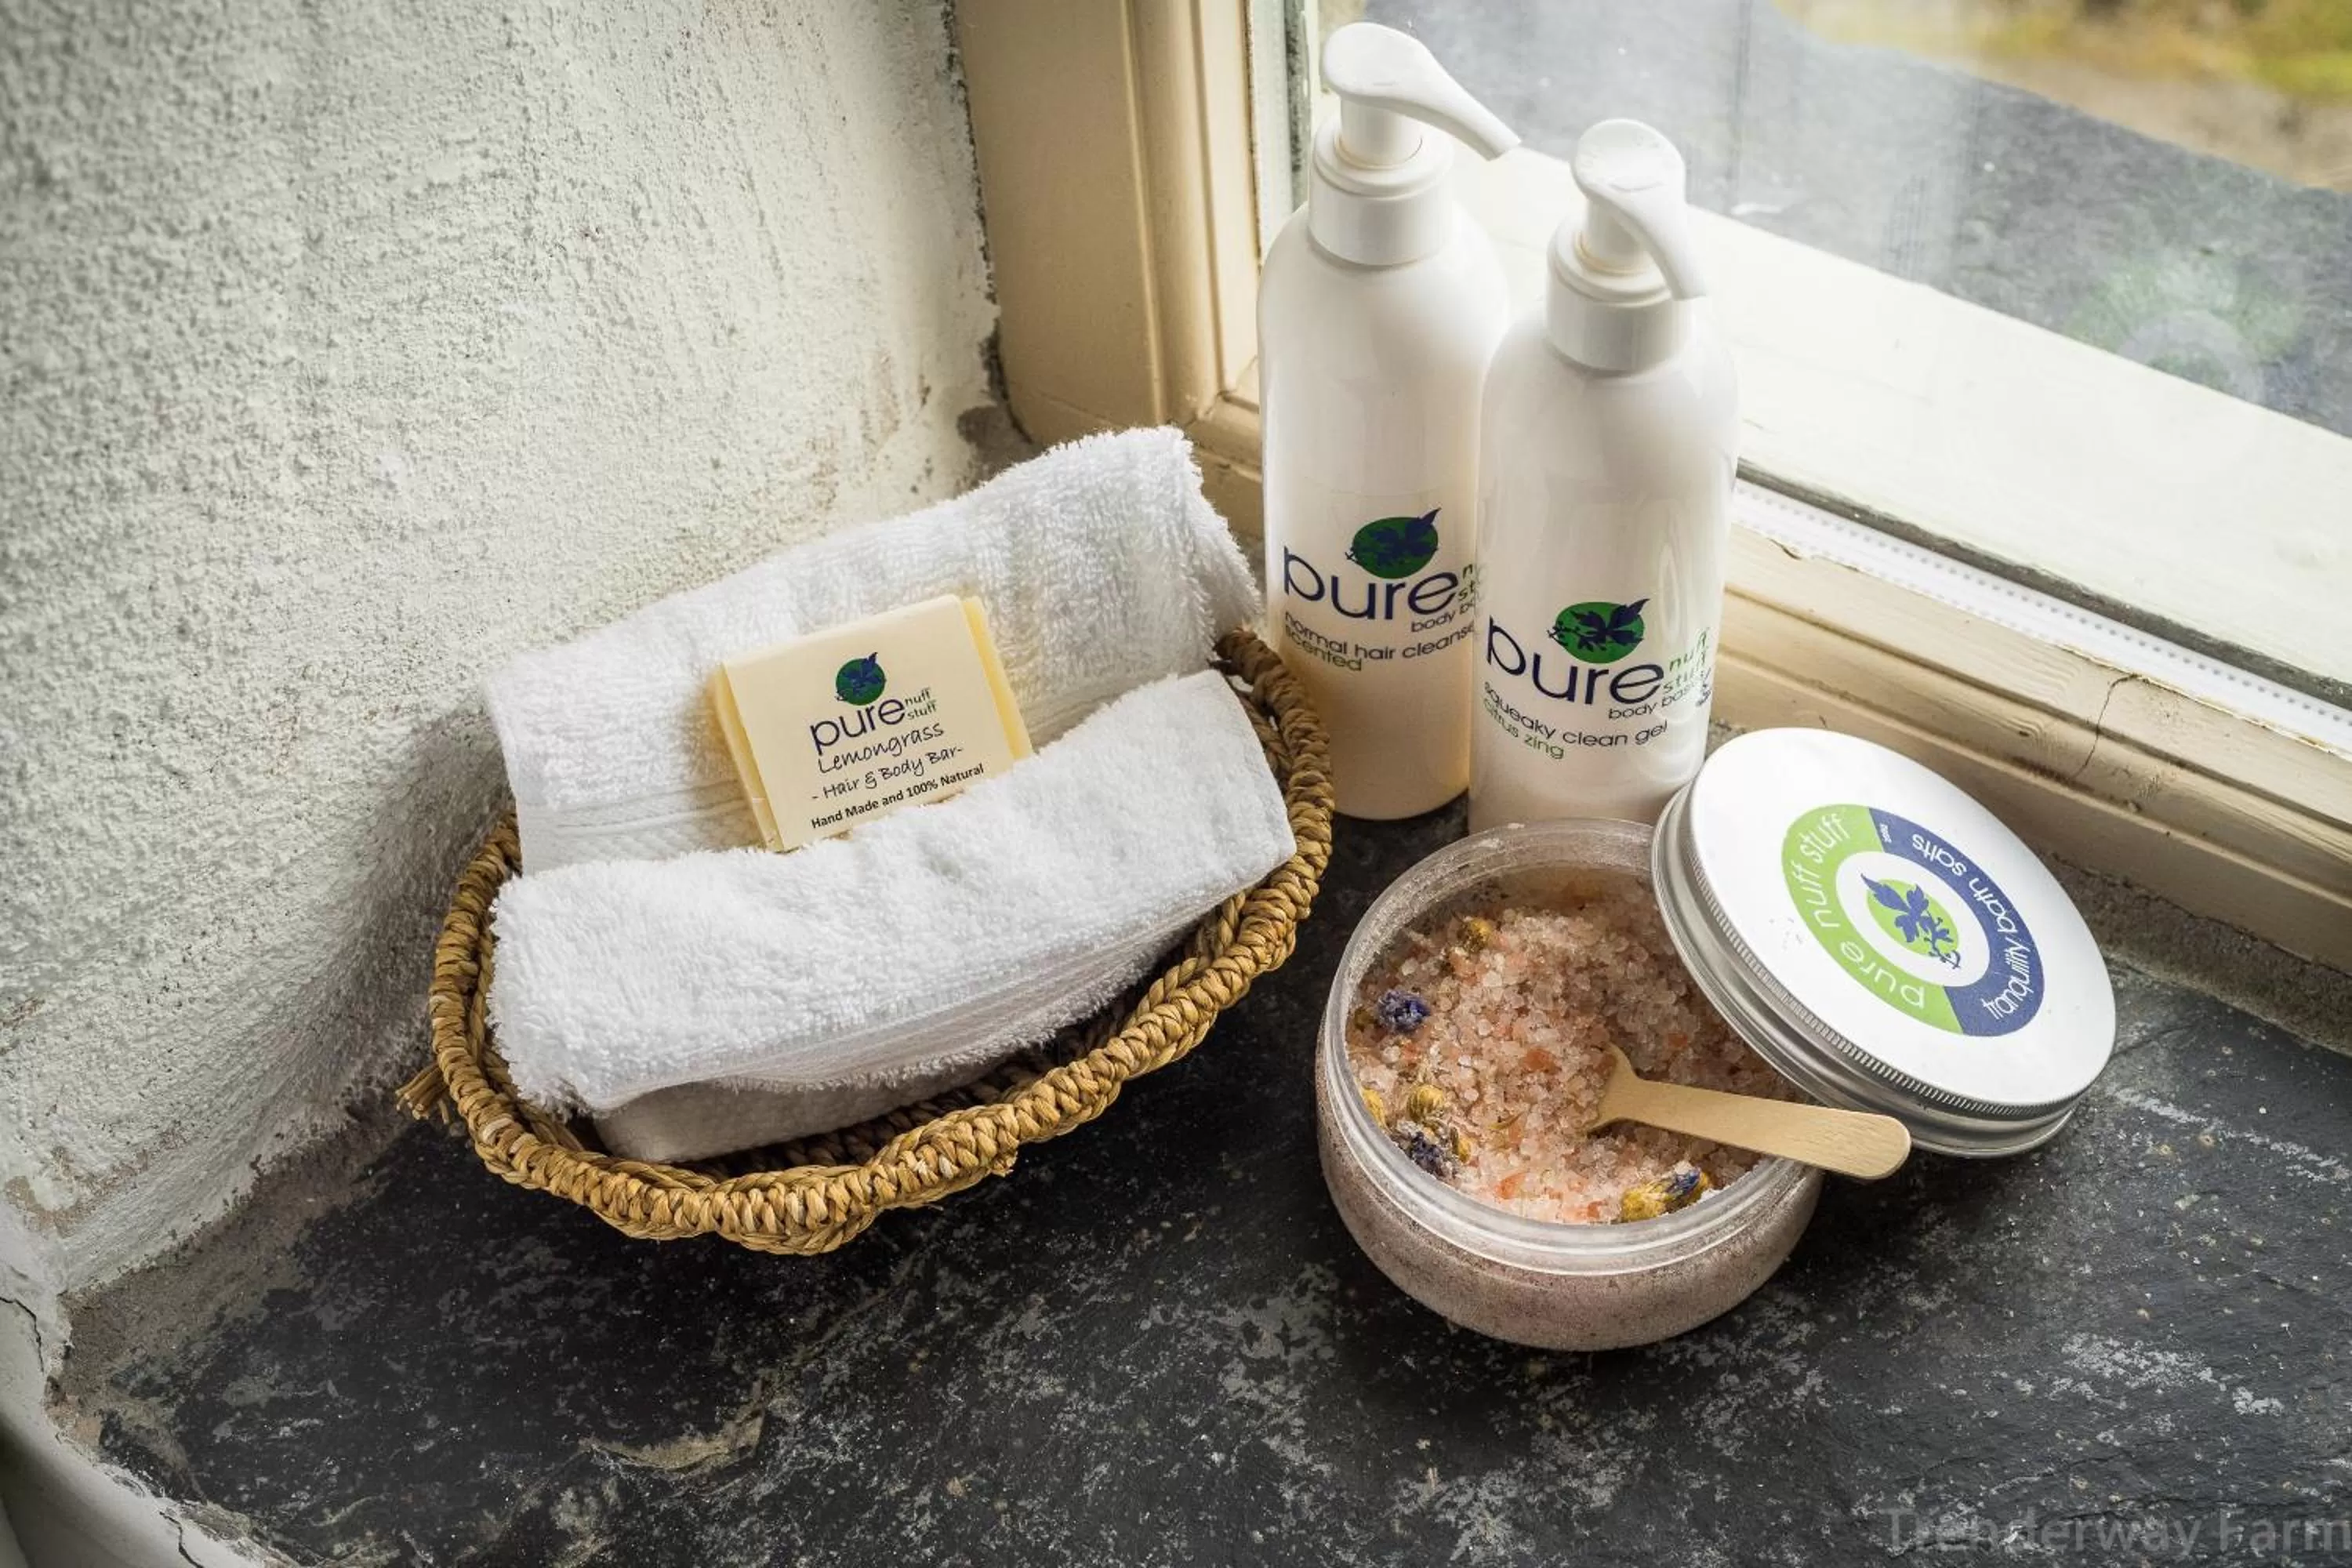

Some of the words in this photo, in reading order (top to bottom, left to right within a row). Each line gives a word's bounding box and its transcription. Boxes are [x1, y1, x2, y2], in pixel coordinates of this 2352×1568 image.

[1283, 546, 1459, 620] pure
[1285, 612, 1348, 655] normal
[1354, 643, 1396, 659] hair
[1411, 611, 1456, 633] body
[1486, 614, 1664, 705] pure
[904, 687, 932, 706] nuff
[906, 702, 938, 720] stuff
[1484, 681, 1557, 740] squeaky
[1563, 730, 1629, 747] clean
[1635, 720, 1668, 746] gel
[1608, 701, 1657, 720] body
[810, 699, 906, 756] pure
[818, 722, 945, 774] Lemongrass
[1524, 733, 1565, 760] zing
[811, 810, 843, 829] Hand
[845, 800, 880, 818] Made
[882, 789, 904, 807] and
[906, 779, 939, 798] 100%
[940, 763, 985, 786] Natural
[822, 778, 861, 799] Hair
[865, 771, 878, 789] &
[878, 758, 924, 782] Body
[1799, 813, 1851, 864] stuff
[1911, 833, 1968, 877] salts
[1791, 859, 1841, 928] nuff
[1969, 877, 2018, 932] bath
[1840, 941, 1926, 1009] pure
